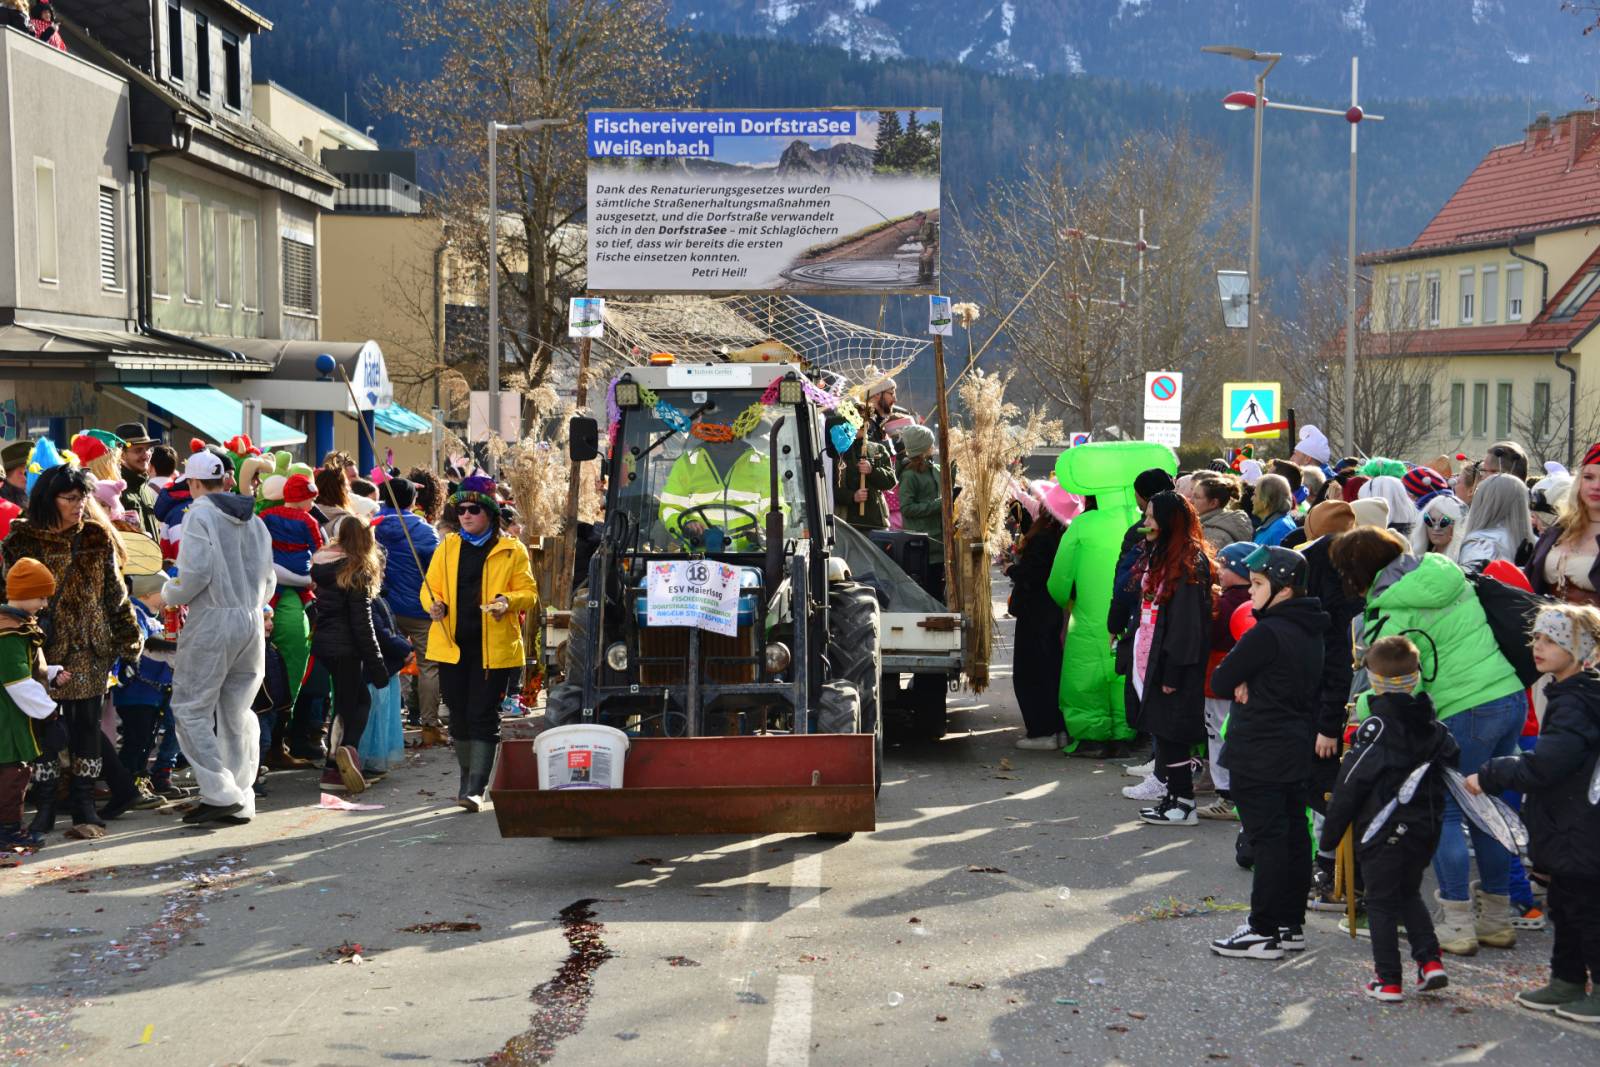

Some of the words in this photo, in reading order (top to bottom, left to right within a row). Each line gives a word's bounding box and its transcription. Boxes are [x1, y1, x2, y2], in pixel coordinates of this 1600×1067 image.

[594, 117, 736, 134] Fischereiverein
[741, 117, 851, 134] DorfstraSee
[594, 139, 710, 156] Weißenbach
[596, 185, 625, 194] Dank
[628, 185, 648, 194] des
[650, 185, 785, 197] Renaturierungsgesetzes
[787, 185, 831, 194] wurden
[595, 198, 651, 208] sämtliche
[653, 198, 831, 211] Straßenerhaltungsmaßnahmen
[595, 212, 658, 224] ausgesetzt,
[662, 212, 684, 221] und
[686, 212, 704, 221] die
[706, 211, 768, 222] Dorfstraße
[770, 211, 835, 222] verwandelt
[595, 225, 618, 235] sich
[620, 225, 632, 235] in
[634, 225, 656, 235] den
[658, 225, 727, 235] DorfstraSee
[738, 225, 758, 235] mit
[760, 225, 839, 238] Schlaglöchern
[595, 241, 609, 249] so
[611, 239, 633, 250] tief,
[636, 239, 662, 249] dass
[664, 239, 683, 249] wir
[685, 239, 725, 249] bereits
[727, 239, 745, 249] die
[747, 240, 783, 249] ersten
[596, 252, 631, 262] Fische
[633, 252, 688, 262] einsetzen
[690, 252, 740, 262] konnten.
[692, 267, 719, 277] Petri
[721, 267, 748, 277] Heil!
[689, 566, 708, 582] 18
[668, 585, 685, 594] ESV
